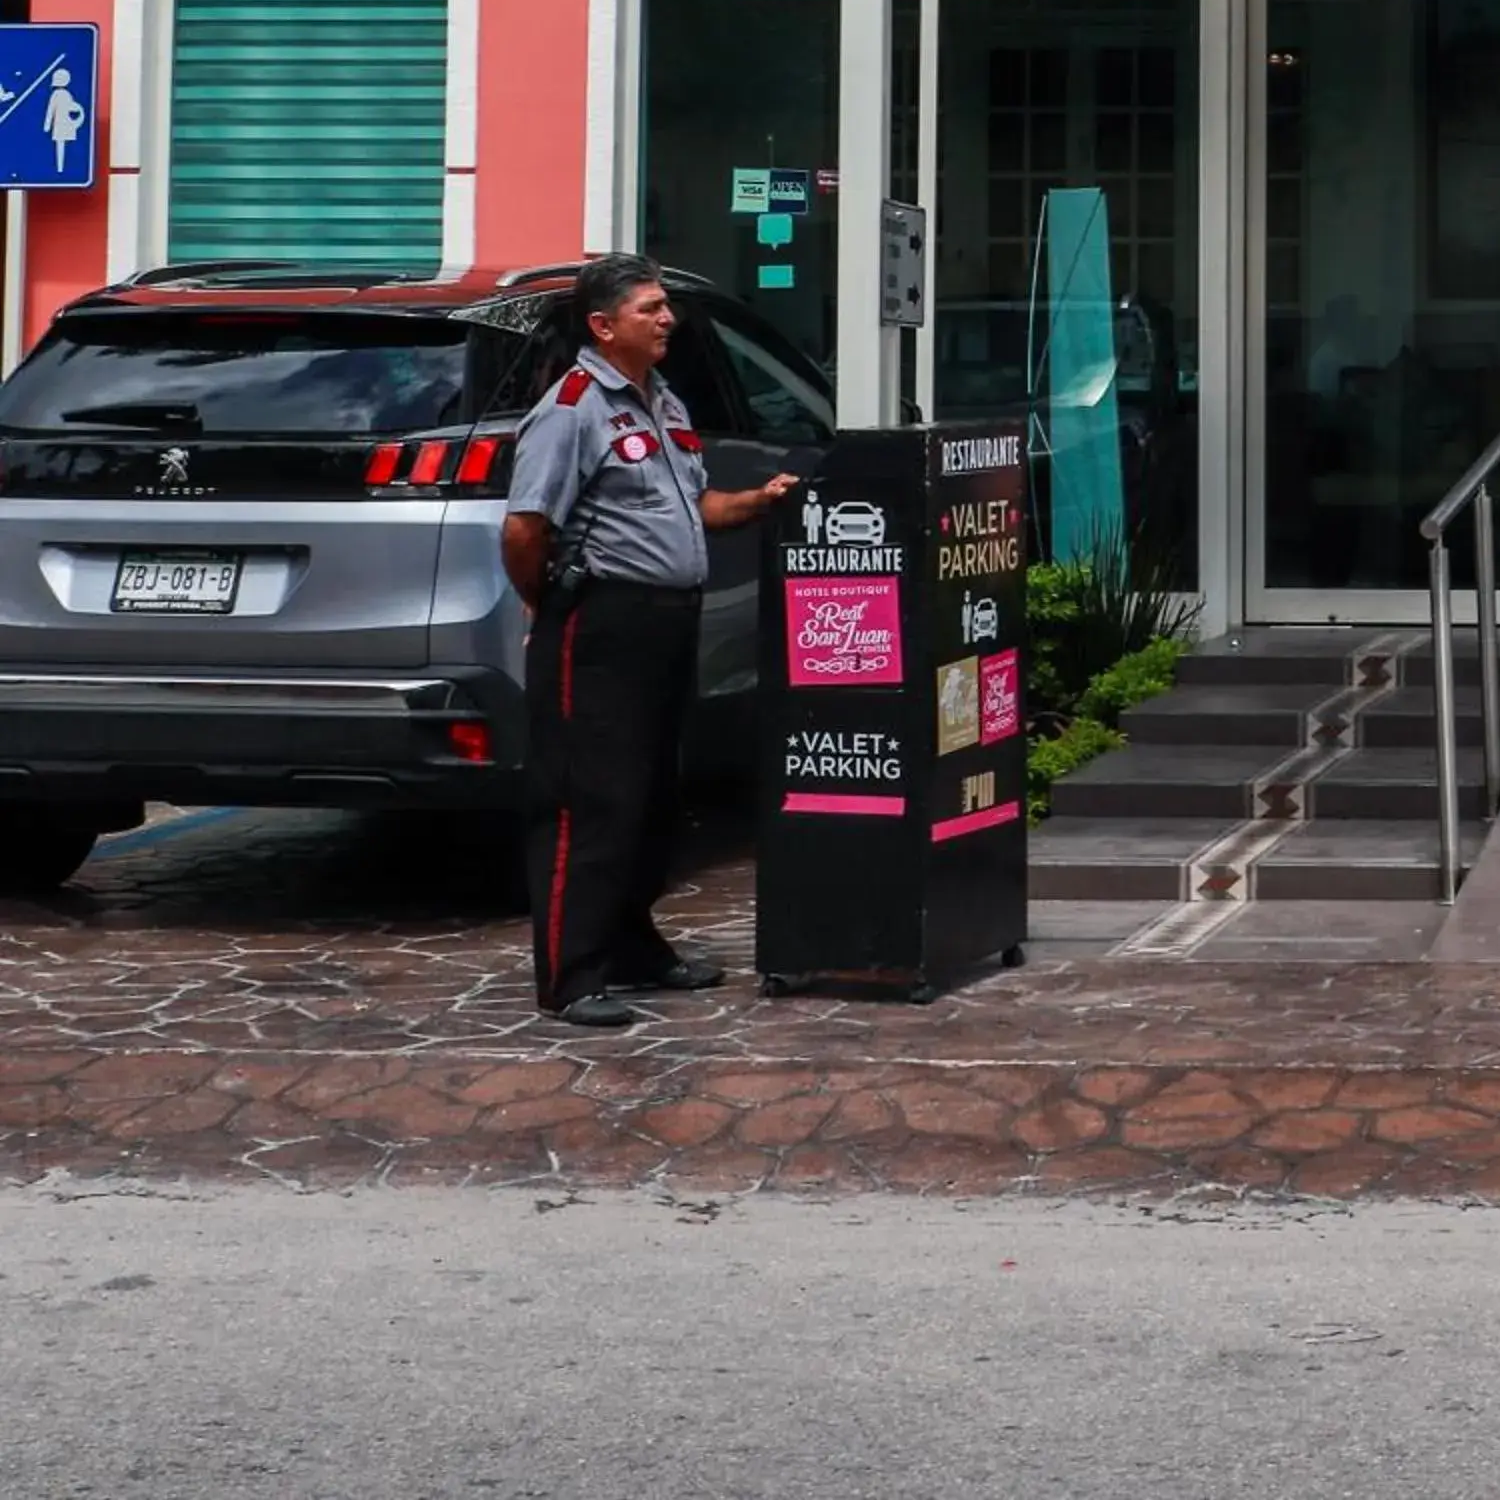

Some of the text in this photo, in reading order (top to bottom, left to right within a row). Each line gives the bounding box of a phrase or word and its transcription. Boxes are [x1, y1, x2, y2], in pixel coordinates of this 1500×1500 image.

[942, 436, 1019, 473] RESTAURANTE
[952, 500, 1009, 537] VALET
[787, 548, 903, 572] RESTAURANTE
[938, 538, 1018, 580] PARKING
[121, 565, 232, 592] ZBJ-081-B
[795, 585, 889, 597] HOTEL BOUTIQUE
[808, 601, 868, 628] Real
[797, 620, 892, 654] San Juan
[802, 732, 885, 755] VALET
[785, 756, 901, 779] PARKING
